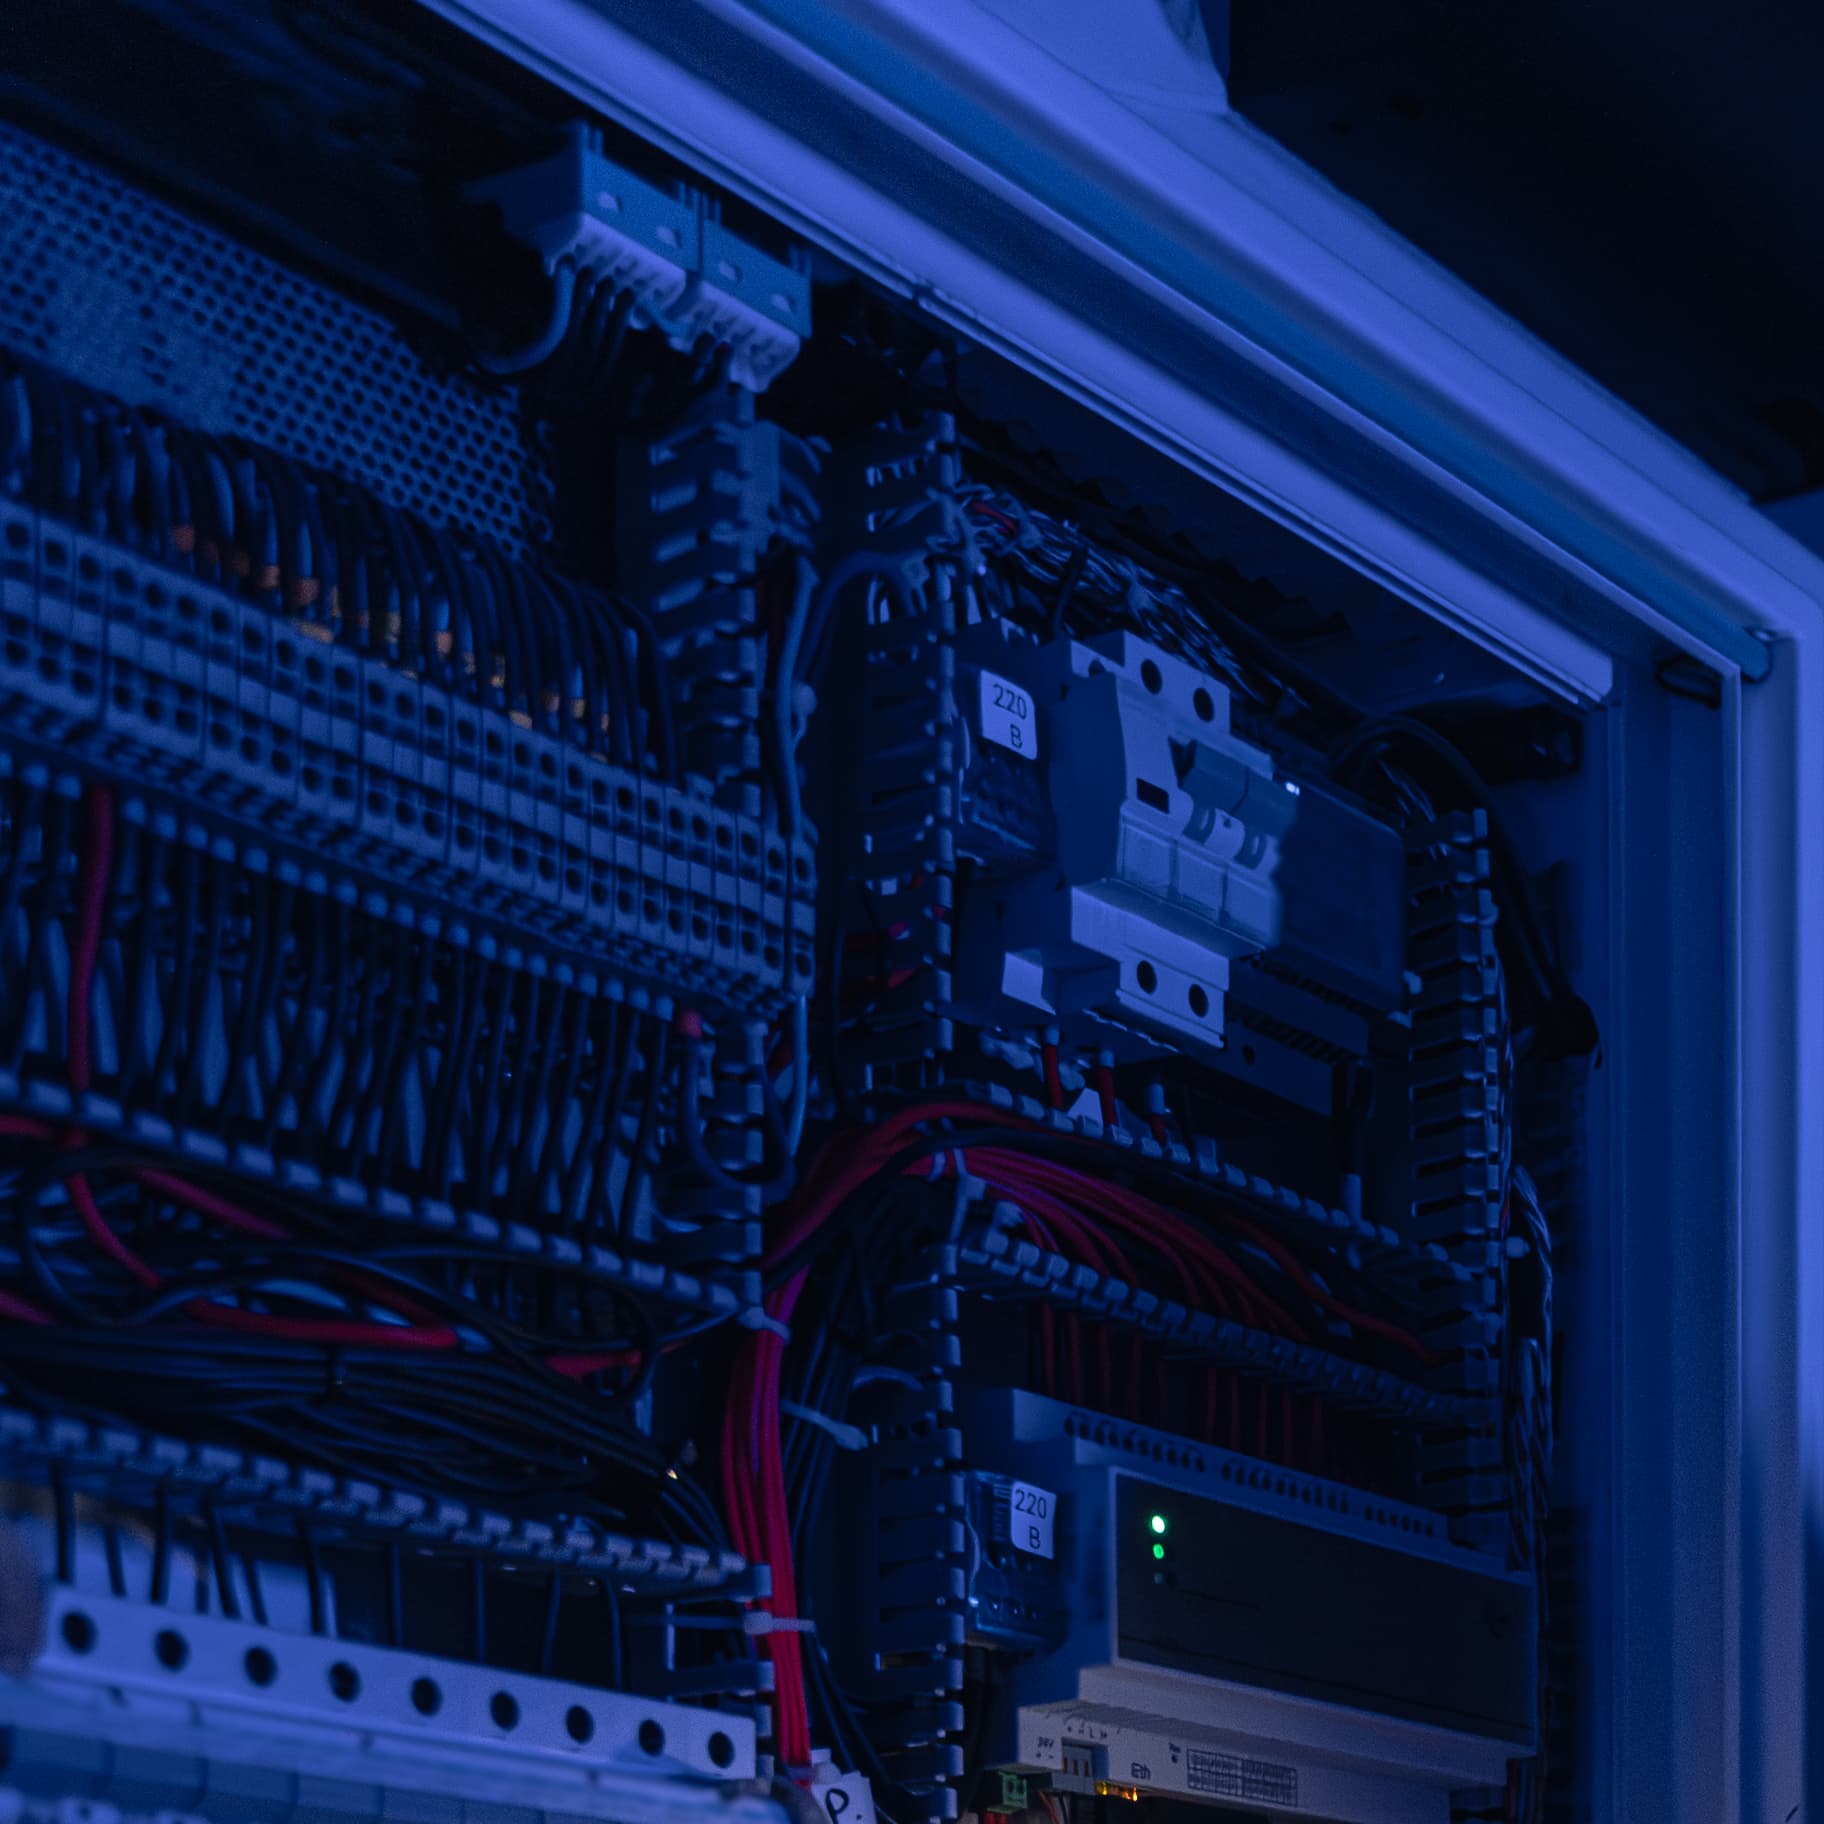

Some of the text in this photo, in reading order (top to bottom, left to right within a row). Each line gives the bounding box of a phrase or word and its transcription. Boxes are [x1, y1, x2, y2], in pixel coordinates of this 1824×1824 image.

[992, 683, 1027, 720] 220
[1010, 723, 1023, 748] B
[1015, 1488, 1047, 1519] 220
[1029, 1525, 1041, 1549] B
[1131, 1761, 1150, 1780] Eth
